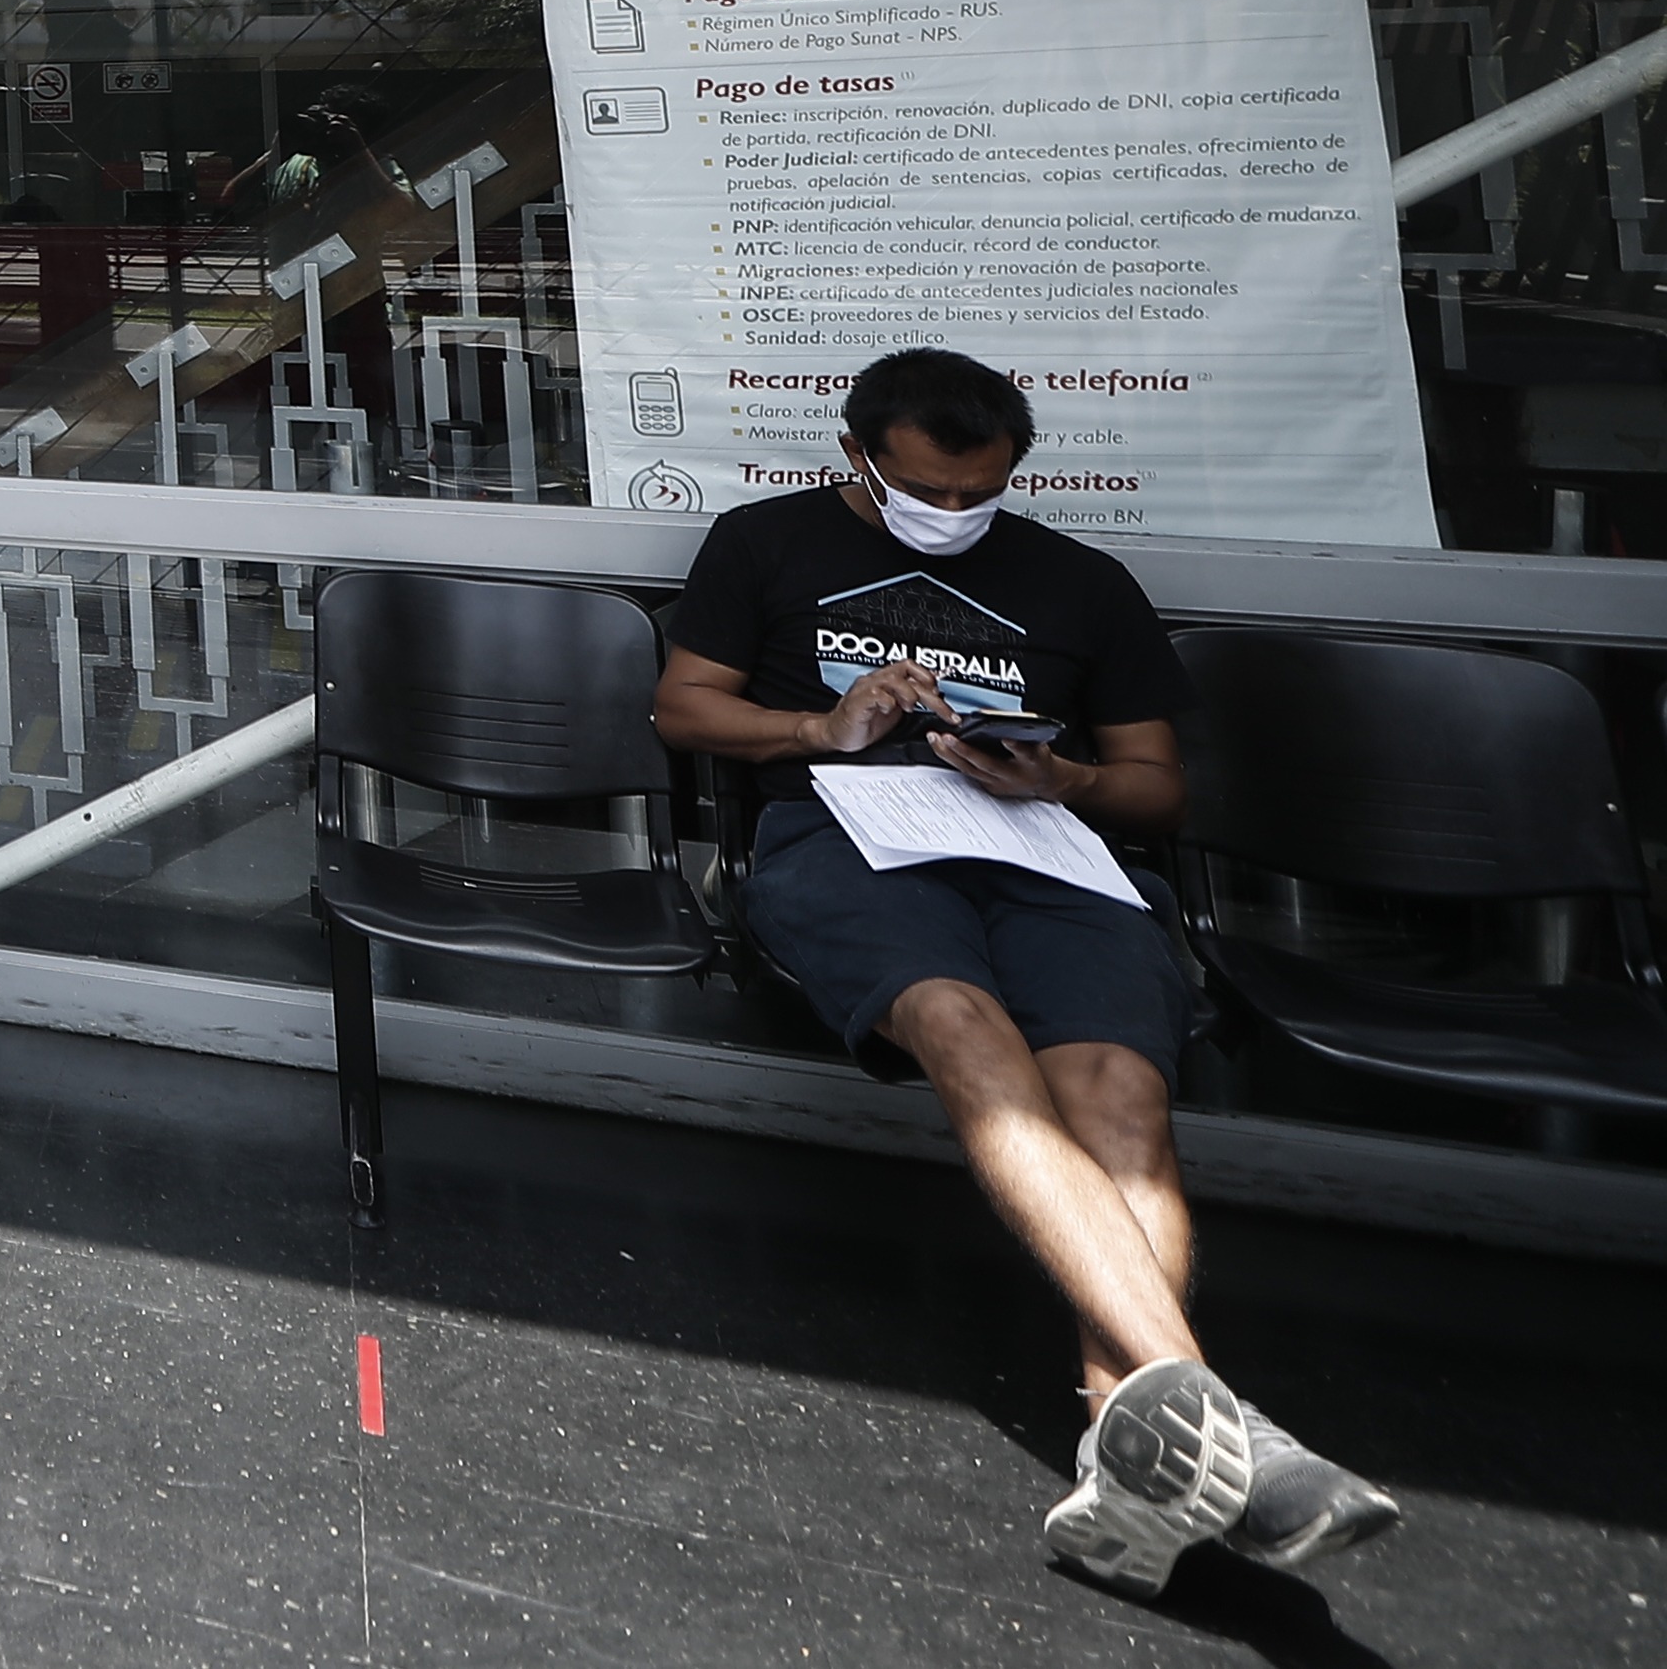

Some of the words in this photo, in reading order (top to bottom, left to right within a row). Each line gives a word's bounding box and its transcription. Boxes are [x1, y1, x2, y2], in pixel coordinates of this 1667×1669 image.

[703, 11, 774, 34] Régimen
[781, 8, 830, 27] Único
[835, 5, 940, 26] Simplificado
[960, 1, 1003, 17] RUS.
[705, 38, 774, 52] Número
[779, 35, 800, 49] de
[806, 33, 845, 51] Pago
[851, 31, 901, 46] Sunat
[921, 26, 962, 42] NPS.
[696, 78, 765, 103] Pago
[775, 74, 810, 95] de
[818, 75, 895, 94] tasas
[720, 109, 787, 125] Reniec:
[794, 105, 888, 124] inscripción,
[895, 101, 995, 118] renovación,
[1002, 97, 1091, 117] duplicado
[1097, 95, 1120, 110] de
[1128, 93, 1173, 109] DNI,
[1181, 91, 1233, 110] copia
[1240, 86, 1340, 106] certificada
[722, 132, 741, 147] de
[747, 130, 811, 150] partida,
[817, 126, 921, 145] rectificación
[926, 125, 947, 140] de
[954, 123, 996, 139] DNI.
[725, 153, 780, 168] Poder
[782, 150, 858, 171] Judicial:
[863, 147, 954, 166] certificado
[959, 146, 980, 161] de
[985, 143, 1109, 160] antecedentes
[1114, 139, 1192, 160] penales,
[1198, 136, 1317, 156] ofrecimiento
[1322, 133, 1345, 149] de
[727, 175, 797, 195] pruebas,
[808, 172, 889, 192] apelación
[900, 171, 921, 186] de
[931, 169, 1031, 185] sentencias,
[1043, 167, 1101, 186] copias
[1112, 162, 1228, 182] certificadas,
[1240, 159, 1314, 176] derecho
[1326, 157, 1349, 173] de
[730, 197, 825, 214] notificación
[829, 194, 896, 214] judicial.
[733, 219, 779, 234] PNP:
[784, 217, 892, 235] identificación
[896, 215, 975, 231] vehicular,
[981, 214, 1061, 229] denuncia
[1066, 211, 1135, 230] policial,
[1140, 208, 1235, 226] certificado
[1239, 208, 1262, 223] de
[1267, 206, 1362, 222] mudanza.
[735, 241, 788, 256] MTC:
[794, 241, 857, 255] licencia
[863, 239, 884, 254] de
[889, 238, 967, 254] conducir,
[974, 236, 1031, 252] récord
[1036, 236, 1059, 251] de
[1064, 235, 1160, 251] conductor.
[737, 263, 860, 282] Migraciones:
[865, 261, 958, 280] expedición
[964, 265, 973, 280] y
[979, 259, 1077, 275] renovación
[1084, 258, 1106, 274] de
[1112, 260, 1210, 278] pasaporte.
[740, 285, 794, 300] INPE:
[800, 285, 889, 302] certificado
[894, 285, 915, 299] de
[921, 280, 1042, 298] antecedentes
[1046, 281, 1133, 302] judiciales
[1140, 280, 1238, 296] nacionales
[742, 308, 805, 323] OSCE:
[810, 307, 912, 326] proveedores
[918, 306, 939, 321] de
[945, 306, 1002, 321] bienes
[1008, 310, 1018, 325] y
[1024, 306, 1100, 320] servicios
[1106, 304, 1133, 320] del
[1140, 304, 1209, 320] Estado.
[745, 330, 826, 345] Sanidad:
[832, 330, 886, 348] dosaje
[892, 329, 949, 344] etílico.
[1044, 368, 1190, 397] telefonía
[1197, 372, 1213, 382] (2)
[746, 403, 797, 419] Claro:
[748, 426, 830, 442] Movistar:
[1056, 432, 1067, 448] y
[1072, 428, 1129, 445] cable.
[738, 462, 865, 487] Transfer
[1009, 468, 1139, 497] epósitos
[1046, 508, 1107, 524] ahorro
[1113, 509, 1149, 525] BN.
[817, 629, 886, 659] DOO
